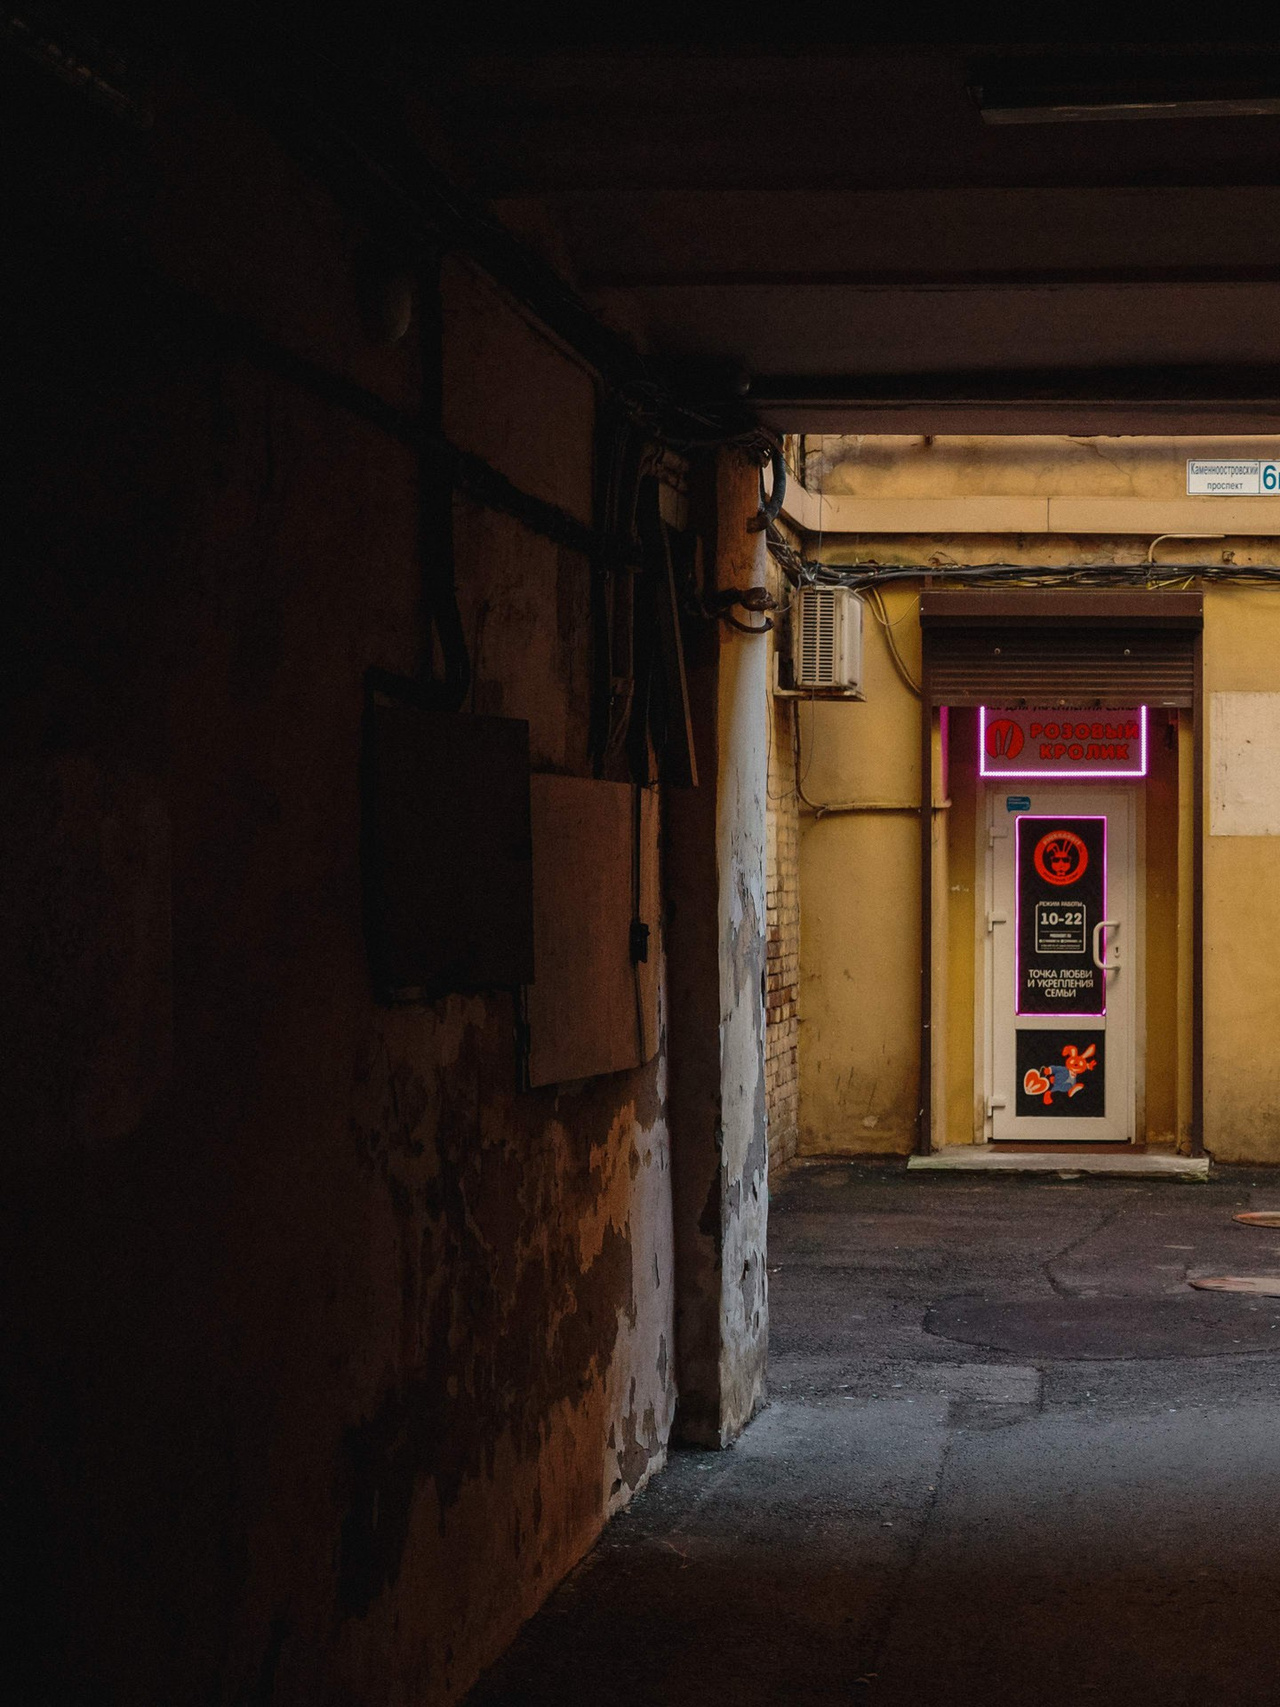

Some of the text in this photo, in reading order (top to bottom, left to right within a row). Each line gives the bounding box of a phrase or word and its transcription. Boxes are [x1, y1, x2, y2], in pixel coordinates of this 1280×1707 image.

[1190, 462, 1259, 477] Каменноостровский
[1207, 481, 1243, 491] проспект
[1030, 720, 1139, 739] РОЗОВЫЙ
[1039, 743, 1130, 760] КРОЛИК
[1040, 912, 1083, 925] 10-22
[1028, 969, 1093, 978] ТОЧКА ЛЮБВИ
[1027, 979, 1094, 988] И УКРЕПЛЕНИЯ
[1045, 989, 1076, 997] СЕМЬИ
